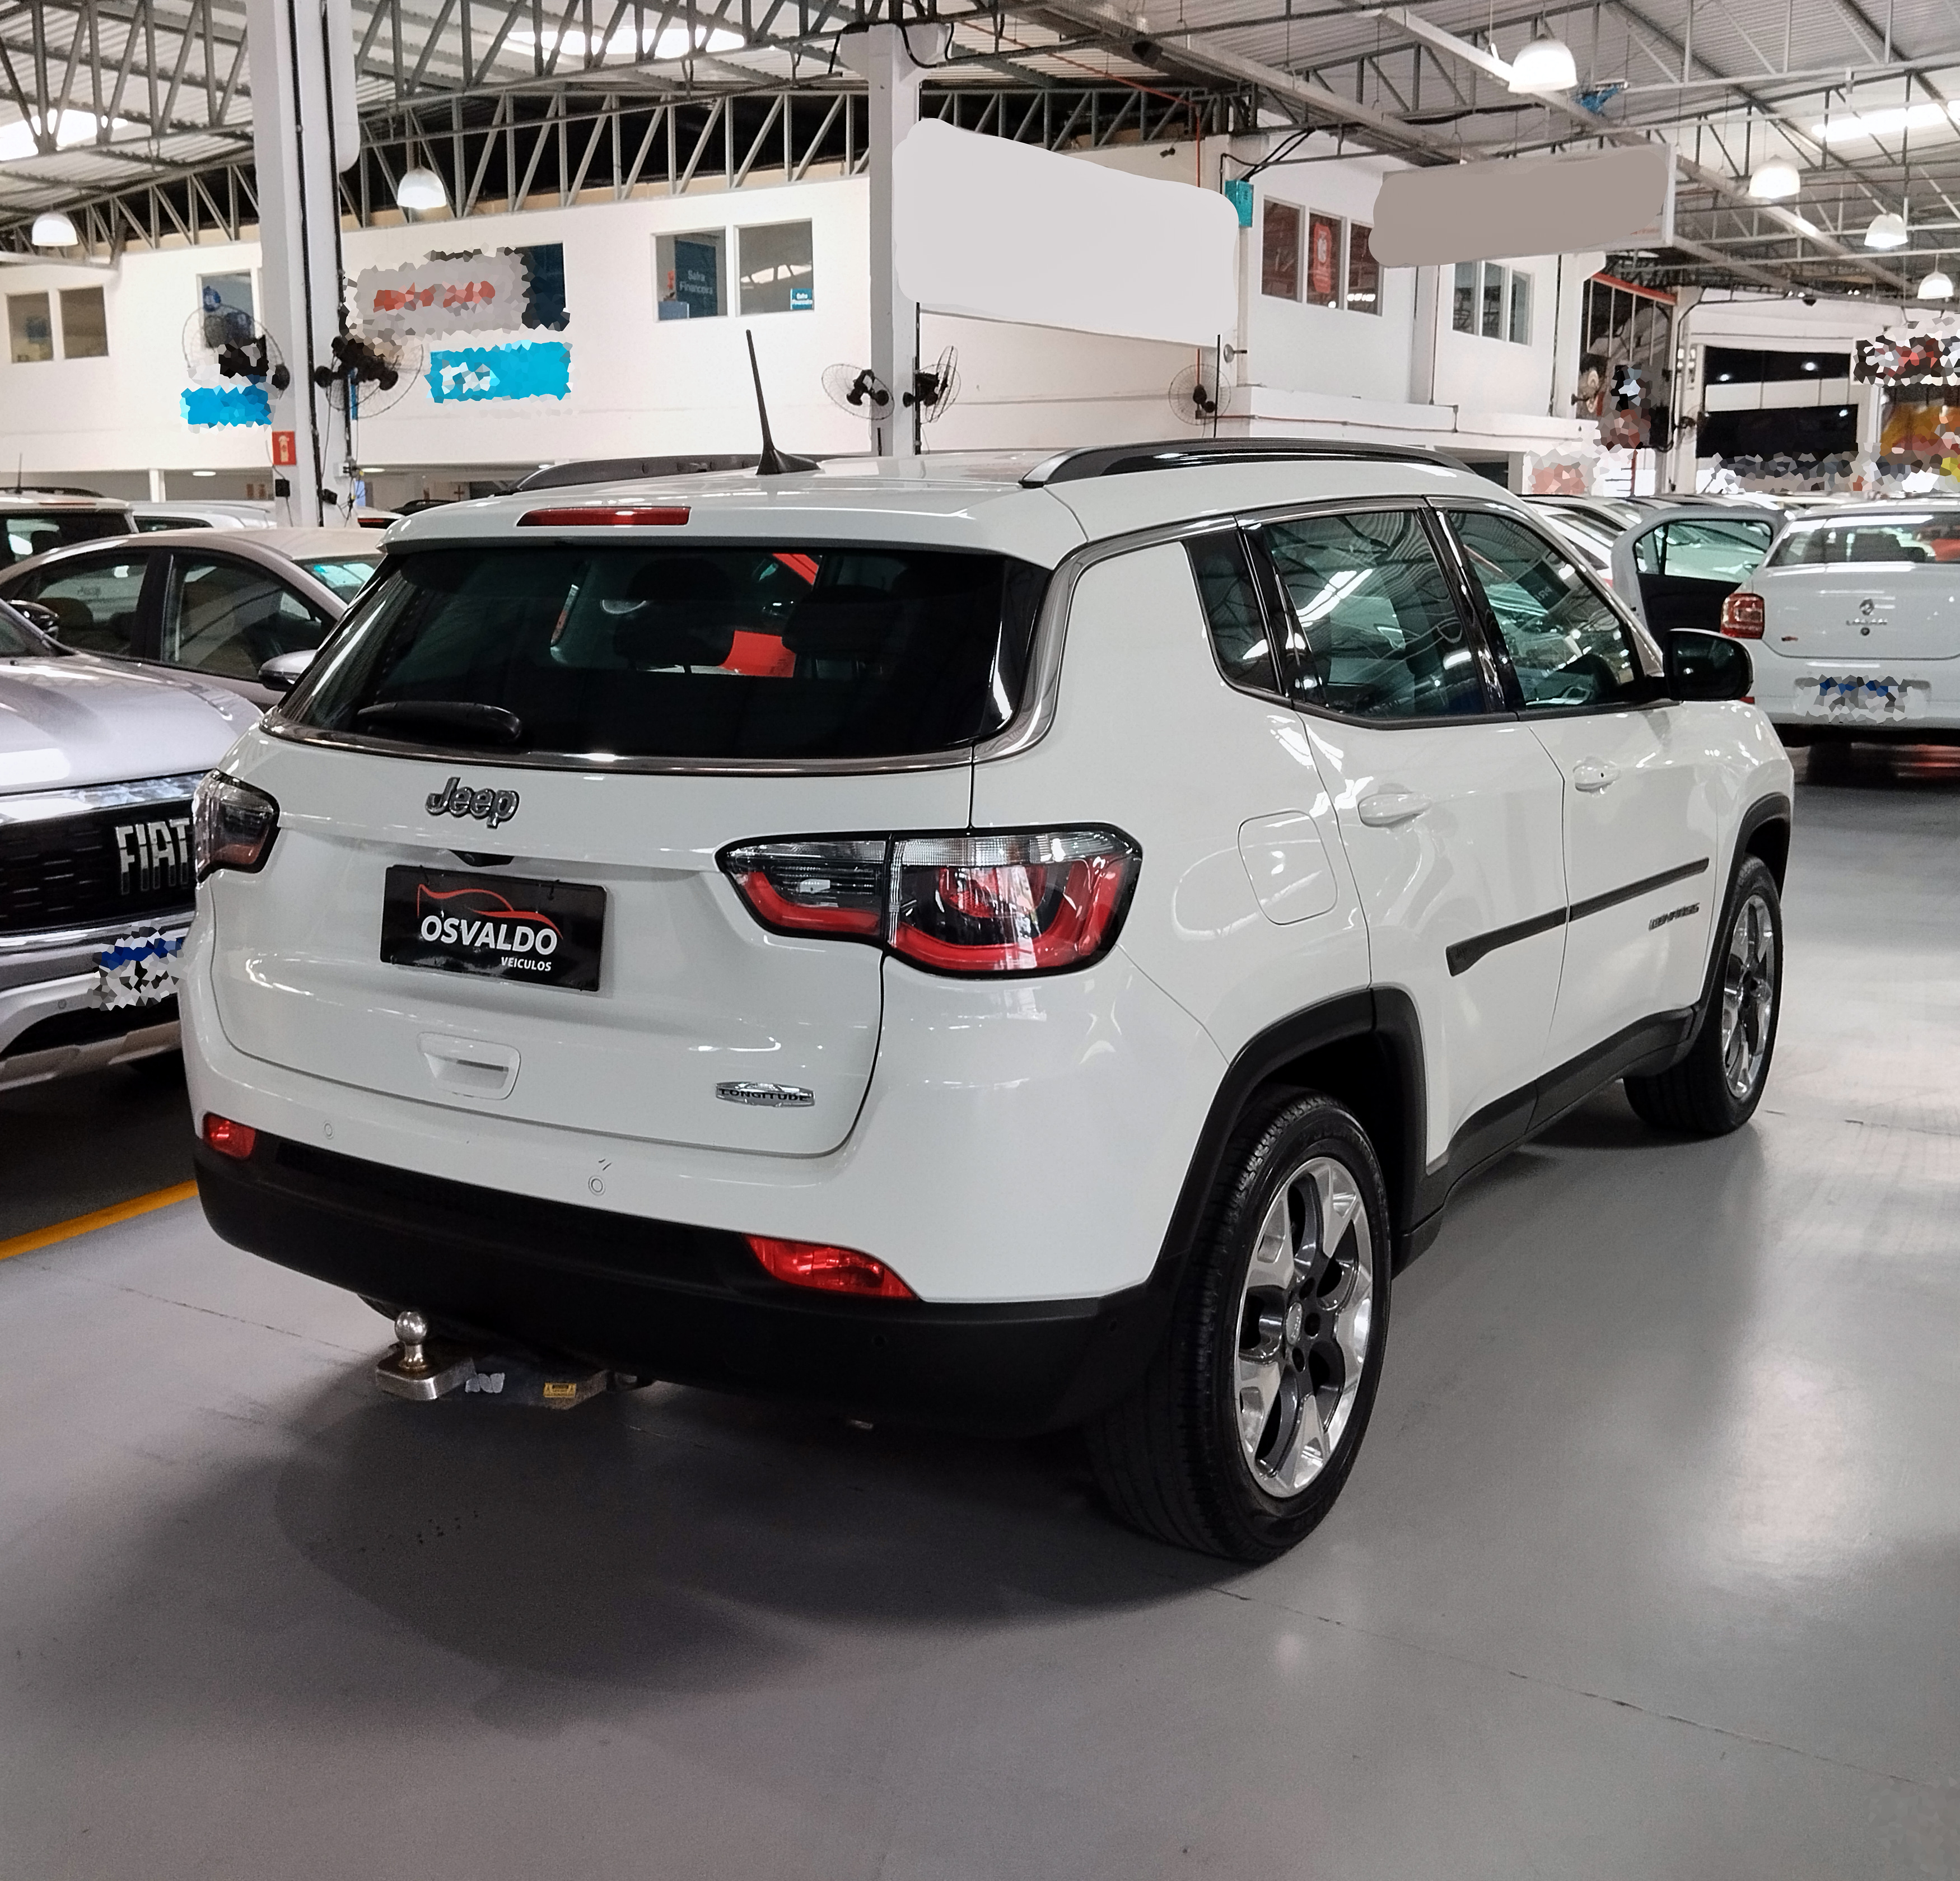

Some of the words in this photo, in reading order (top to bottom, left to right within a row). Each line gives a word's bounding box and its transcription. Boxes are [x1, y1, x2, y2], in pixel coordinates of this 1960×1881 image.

[425, 777, 520, 829] Jeep
[115, 818, 190, 895] FIAT
[421, 915, 557, 955] OSVALDO
[501, 956, 552, 972] VEICULOS
